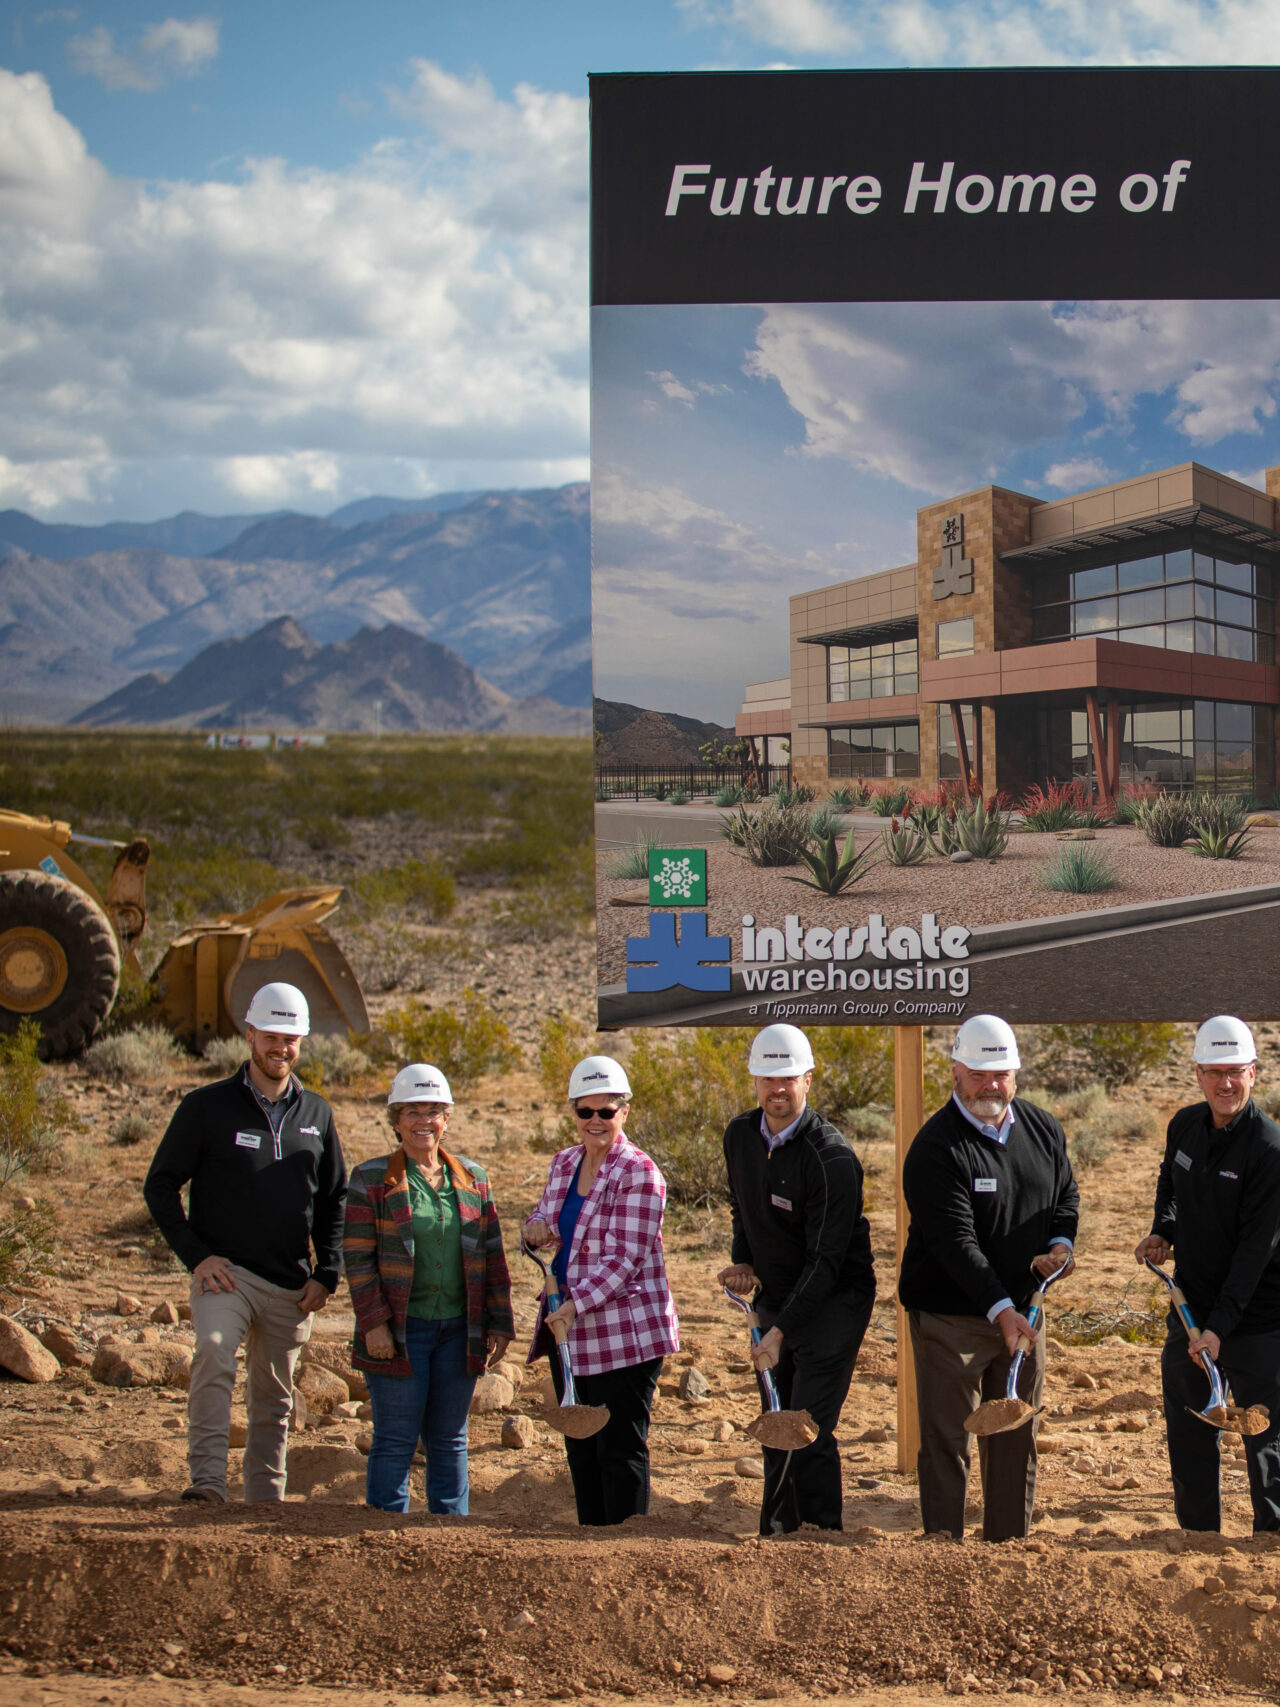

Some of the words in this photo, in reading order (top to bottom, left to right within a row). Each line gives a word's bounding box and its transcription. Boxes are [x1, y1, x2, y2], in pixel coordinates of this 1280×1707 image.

[664, 164, 882, 216] Future
[903, 161, 1097, 214] Home
[1119, 159, 1192, 213] of
[741, 913, 972, 961] interstate
[741, 961, 970, 997] warehousing
[748, 1003, 758, 1016] a
[764, 1001, 838, 1018] Tippmann
[842, 1000, 890, 1017] Group
[893, 999, 966, 1017] Company
